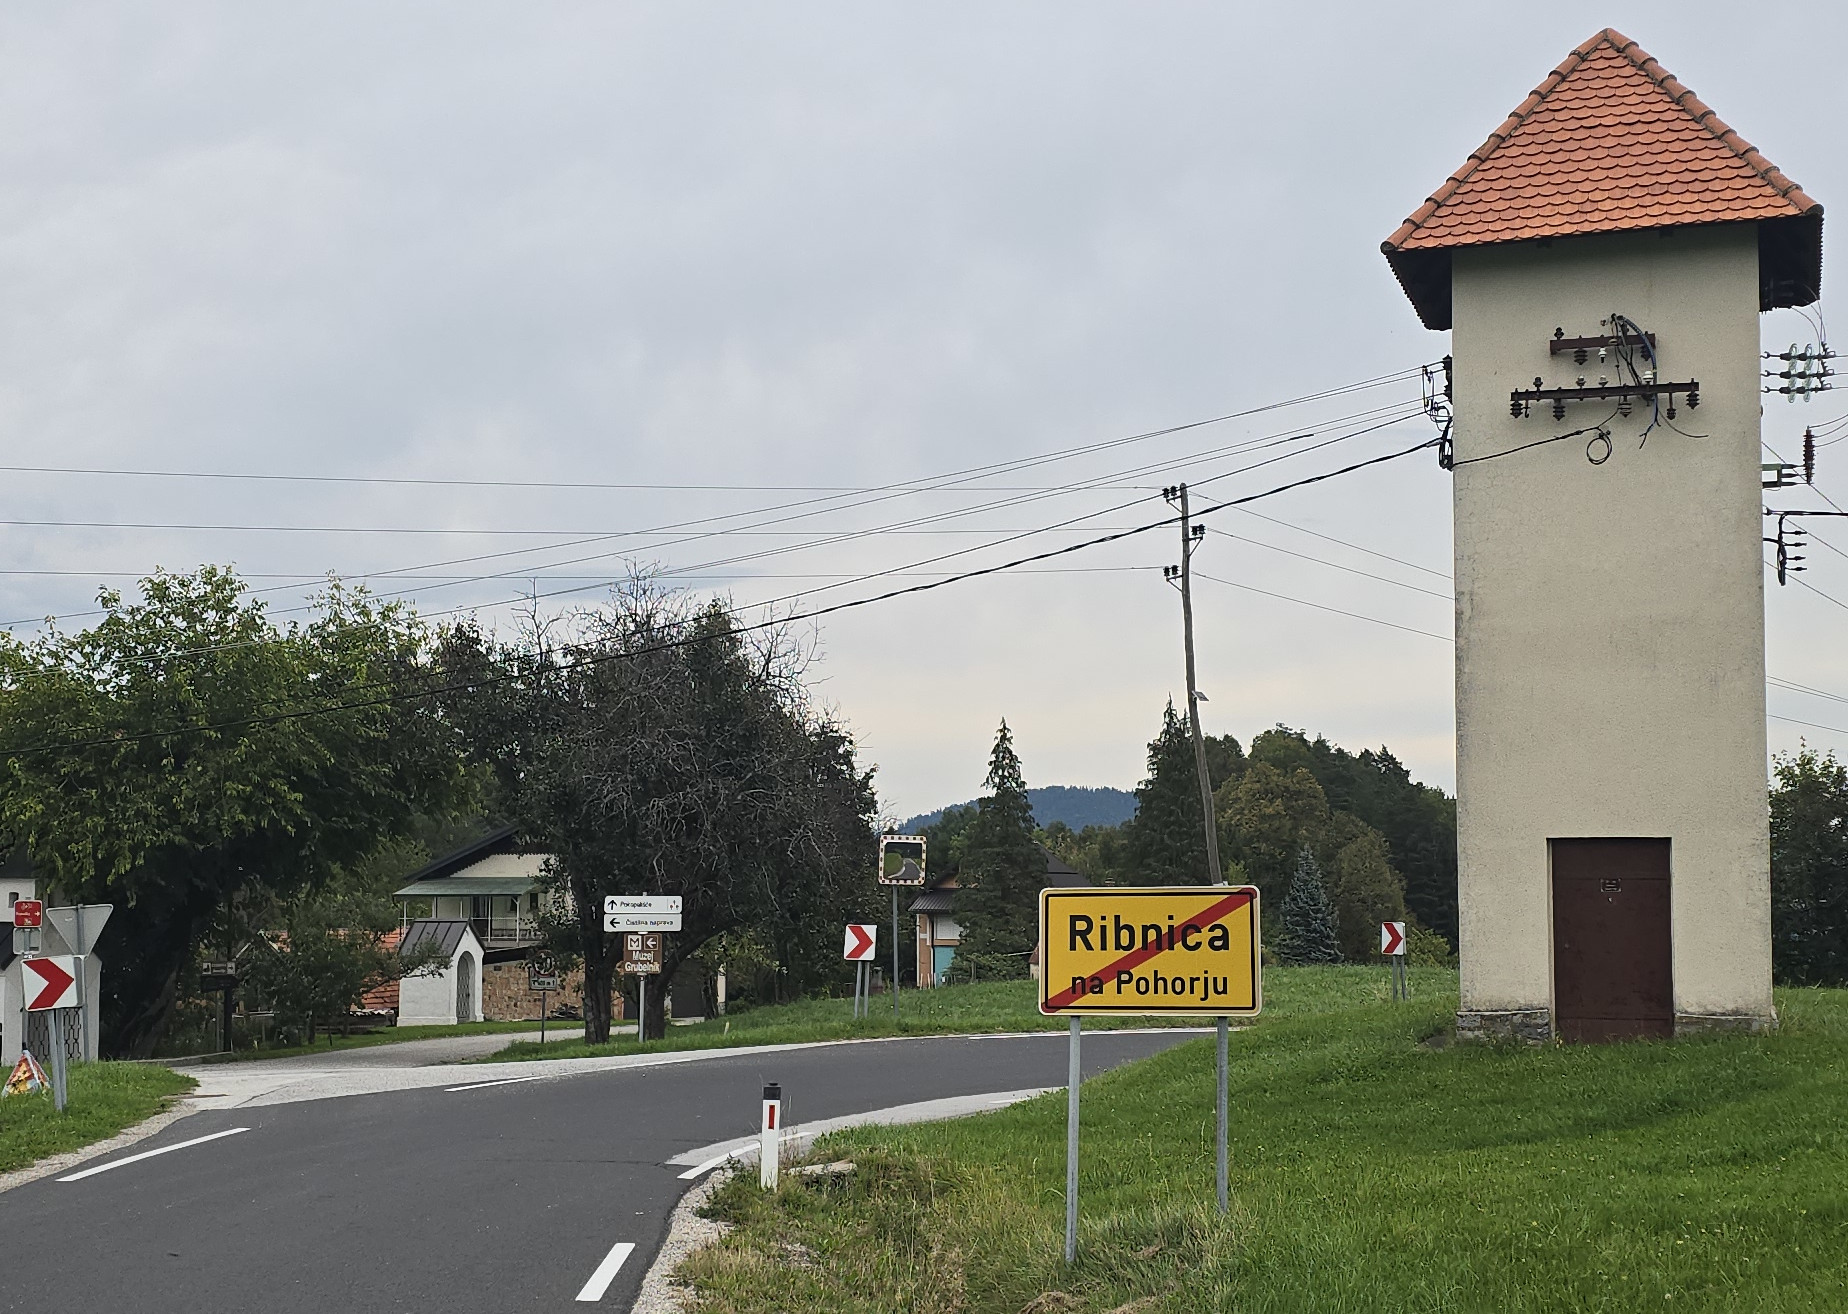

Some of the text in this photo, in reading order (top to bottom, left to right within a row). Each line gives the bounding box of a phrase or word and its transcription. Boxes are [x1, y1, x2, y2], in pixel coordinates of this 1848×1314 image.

[1069, 914, 1230, 952] Ribnica
[625, 962, 660, 972] Grubelnik
[632, 951, 653, 962] Muzej
[1071, 970, 1228, 1002] na Pohorju
